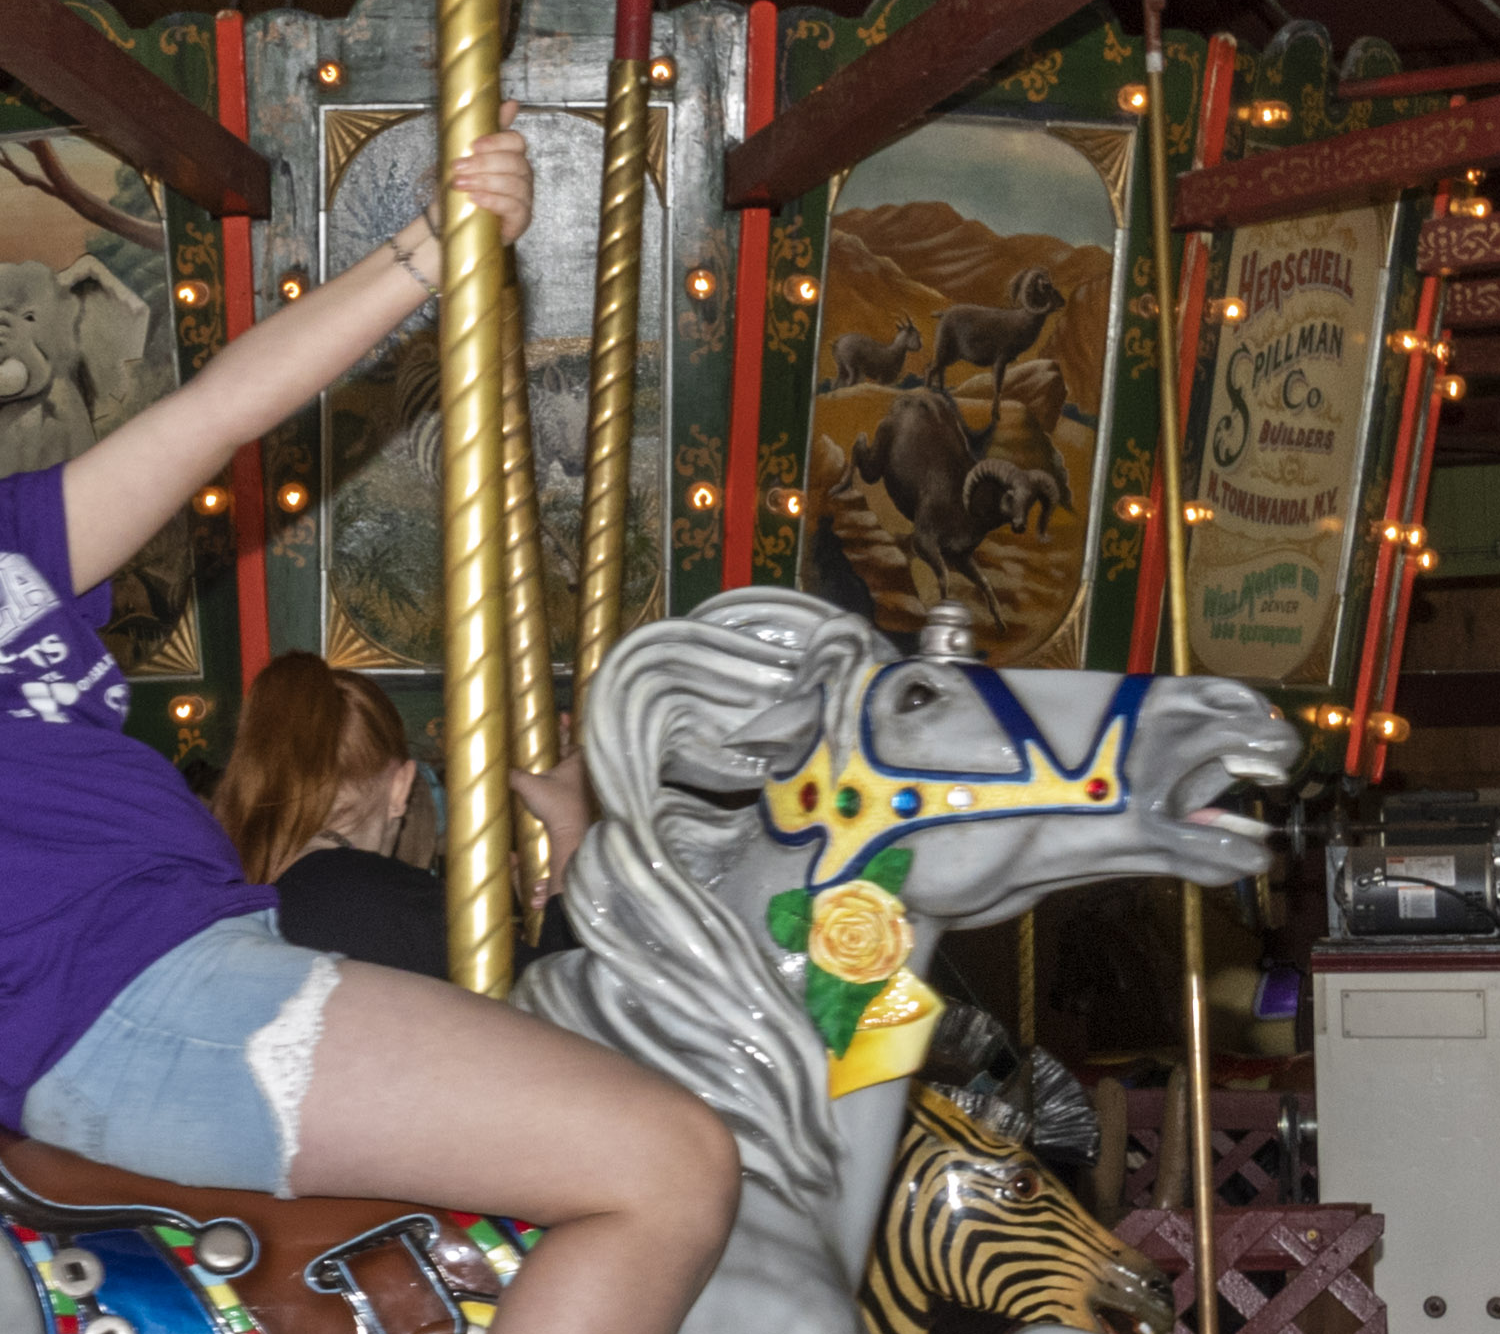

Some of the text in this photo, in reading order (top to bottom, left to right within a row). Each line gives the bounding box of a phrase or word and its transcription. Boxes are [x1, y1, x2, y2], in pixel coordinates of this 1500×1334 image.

[1233, 248, 1355, 335] HERSCHELL
[1212, 321, 1345, 468] SPILLMAN
[1258, 419, 1336, 454] BUILDERS
[1206, 470, 1220, 505] N.
[1260, 600, 1299, 613] DENVER
